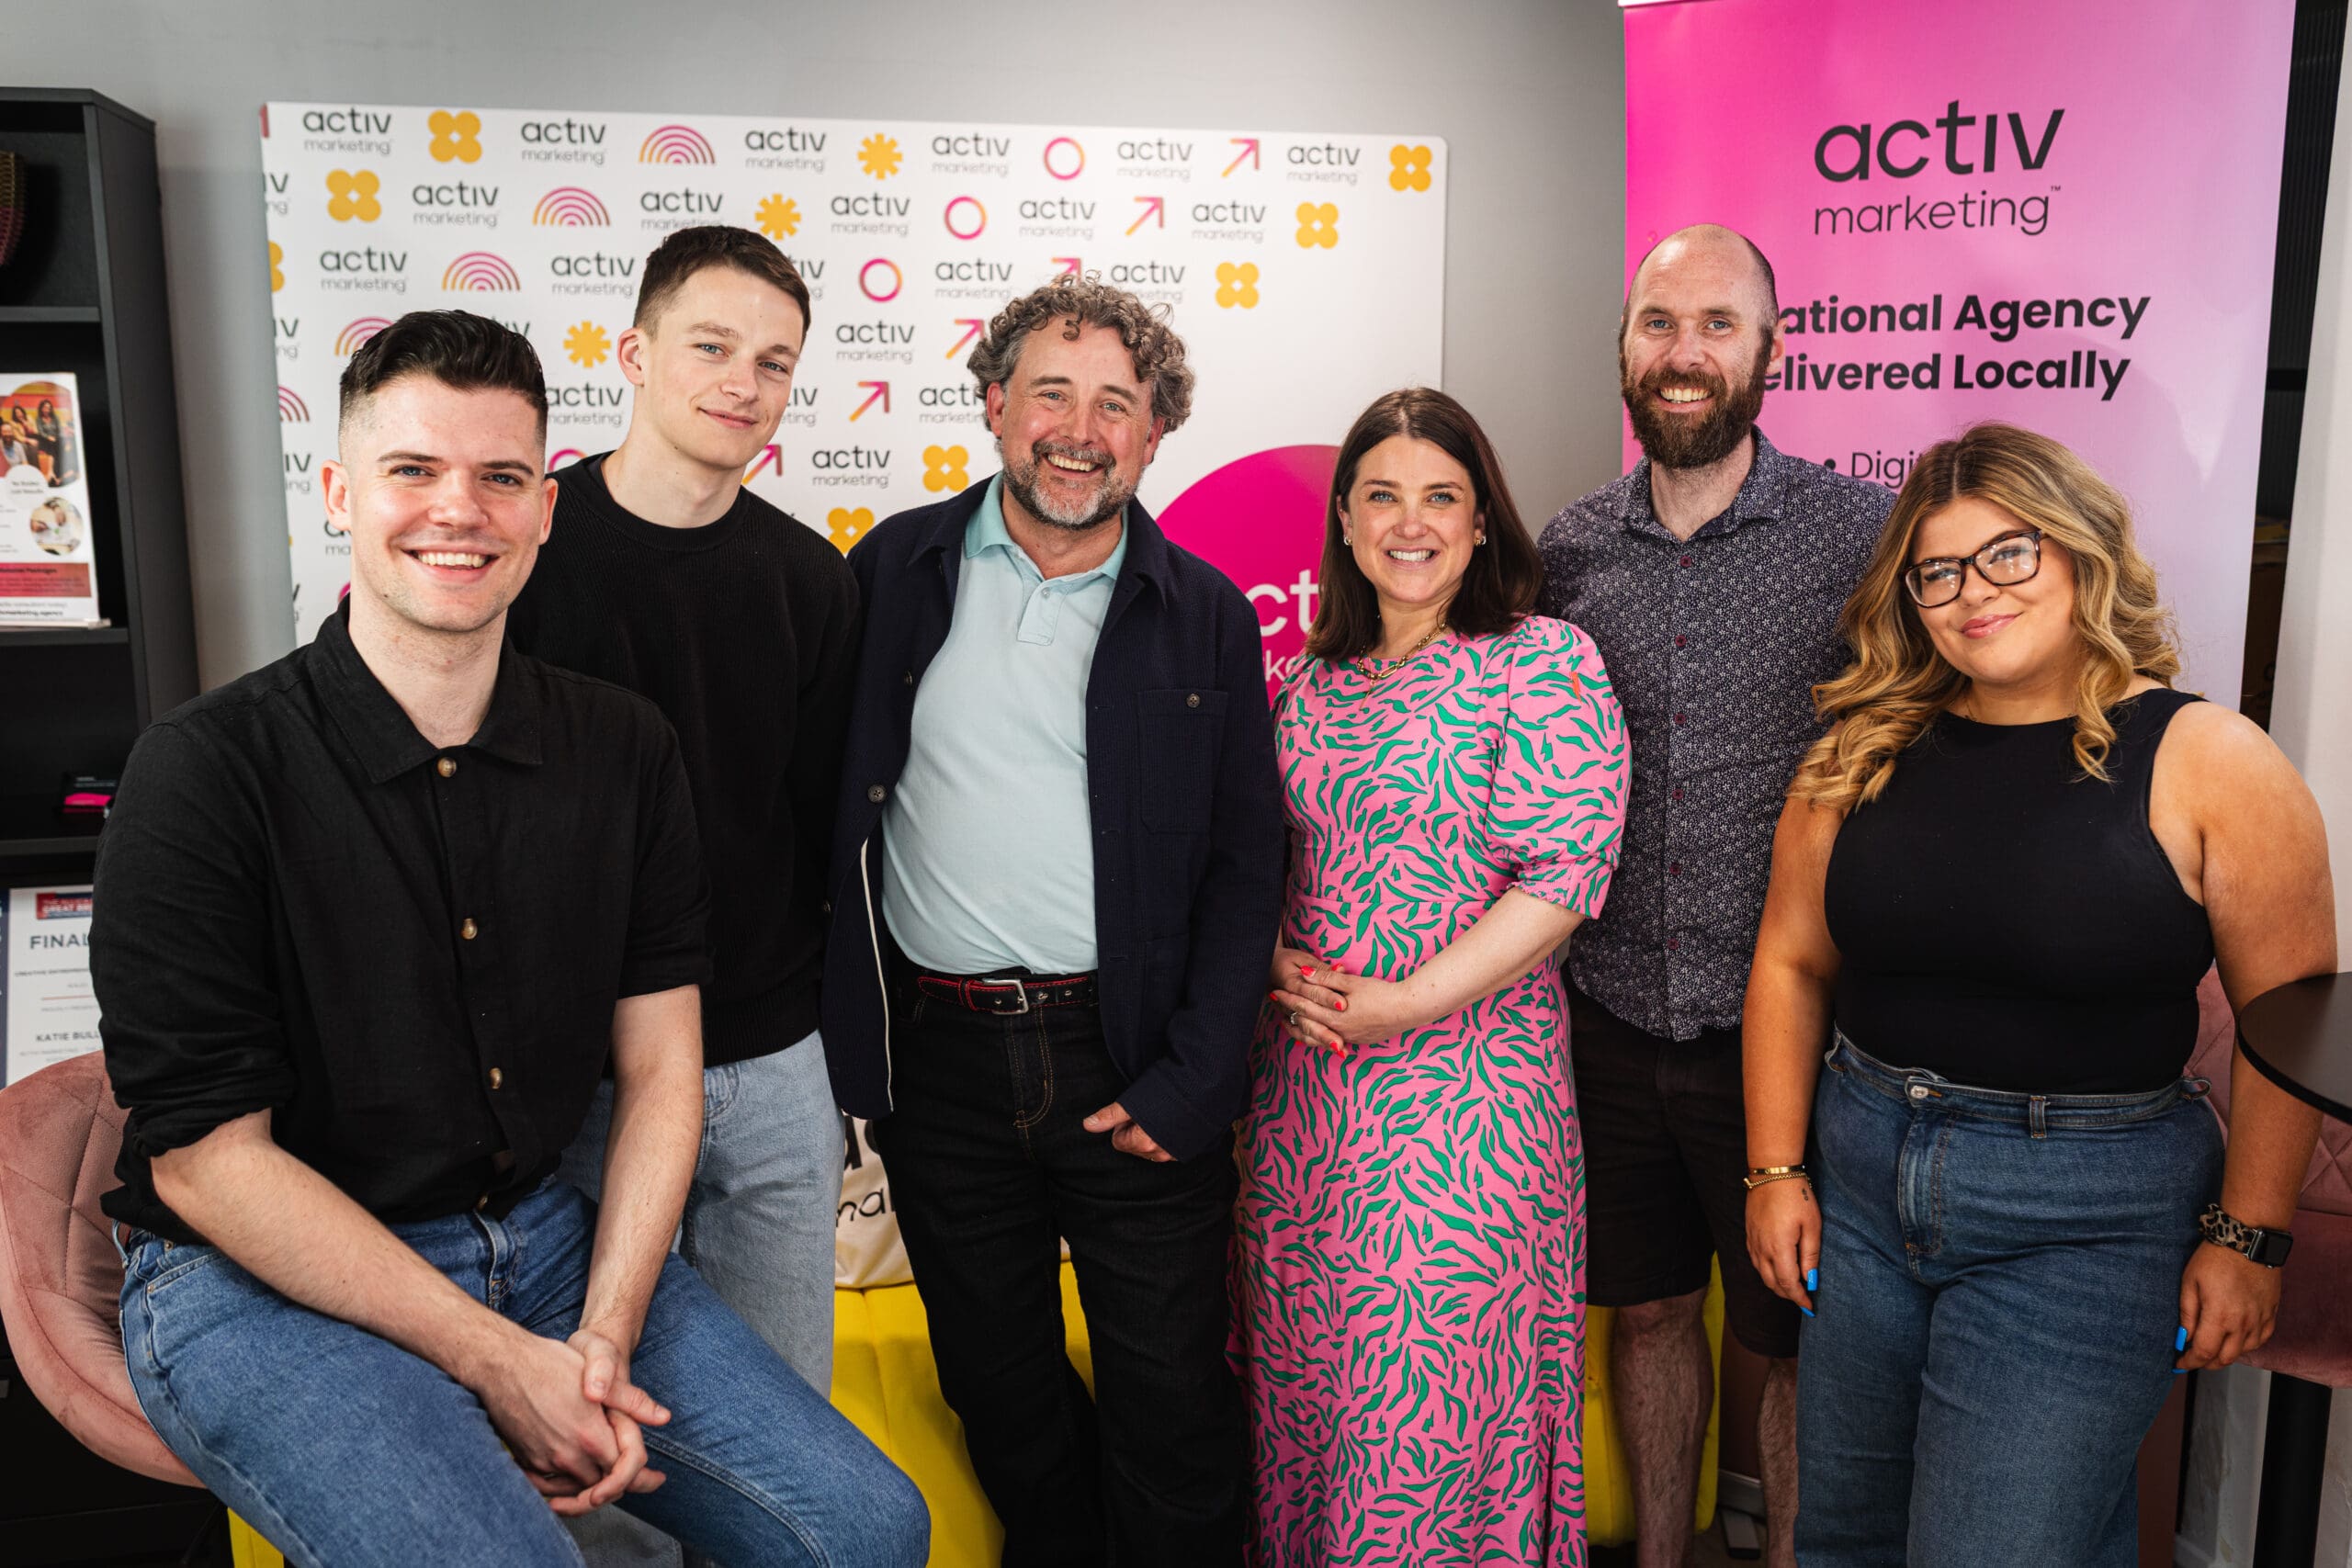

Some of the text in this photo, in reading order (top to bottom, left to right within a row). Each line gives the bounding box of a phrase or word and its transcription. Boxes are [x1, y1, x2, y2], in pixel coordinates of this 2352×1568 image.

[302, 107, 391, 134] activ
[521, 118, 605, 144] activ
[304, 140, 390, 155] marketing
[745, 127, 826, 152] activ
[932, 133, 1010, 156] activ
[1116, 139, 1193, 162] activ
[1815, 99, 2064, 183] activ
[522, 150, 604, 166] marketing
[745, 158, 824, 173] marketing
[1287, 143, 1360, 165] activ
[413, 181, 498, 207] activ
[640, 188, 722, 213] activ
[831, 193, 910, 217] activ
[1020, 197, 1095, 220] activ
[1192, 201, 1266, 223] activ
[413, 212, 497, 229] marketing
[320, 247, 407, 272] activ
[551, 253, 634, 276] activ
[935, 259, 1012, 282] activ
[1110, 261, 1185, 284] activ
[321, 277, 406, 294] marketing
[551, 283, 633, 298] marketing
[1780, 294, 2151, 343] ational Agency
[836, 321, 914, 344] activ
[1954, 350, 2131, 400] Locally
[546, 381, 623, 407] activ
[812, 446, 890, 469] activ
[812, 475, 888, 489] marketing
[30, 932, 89, 950] FINAL
